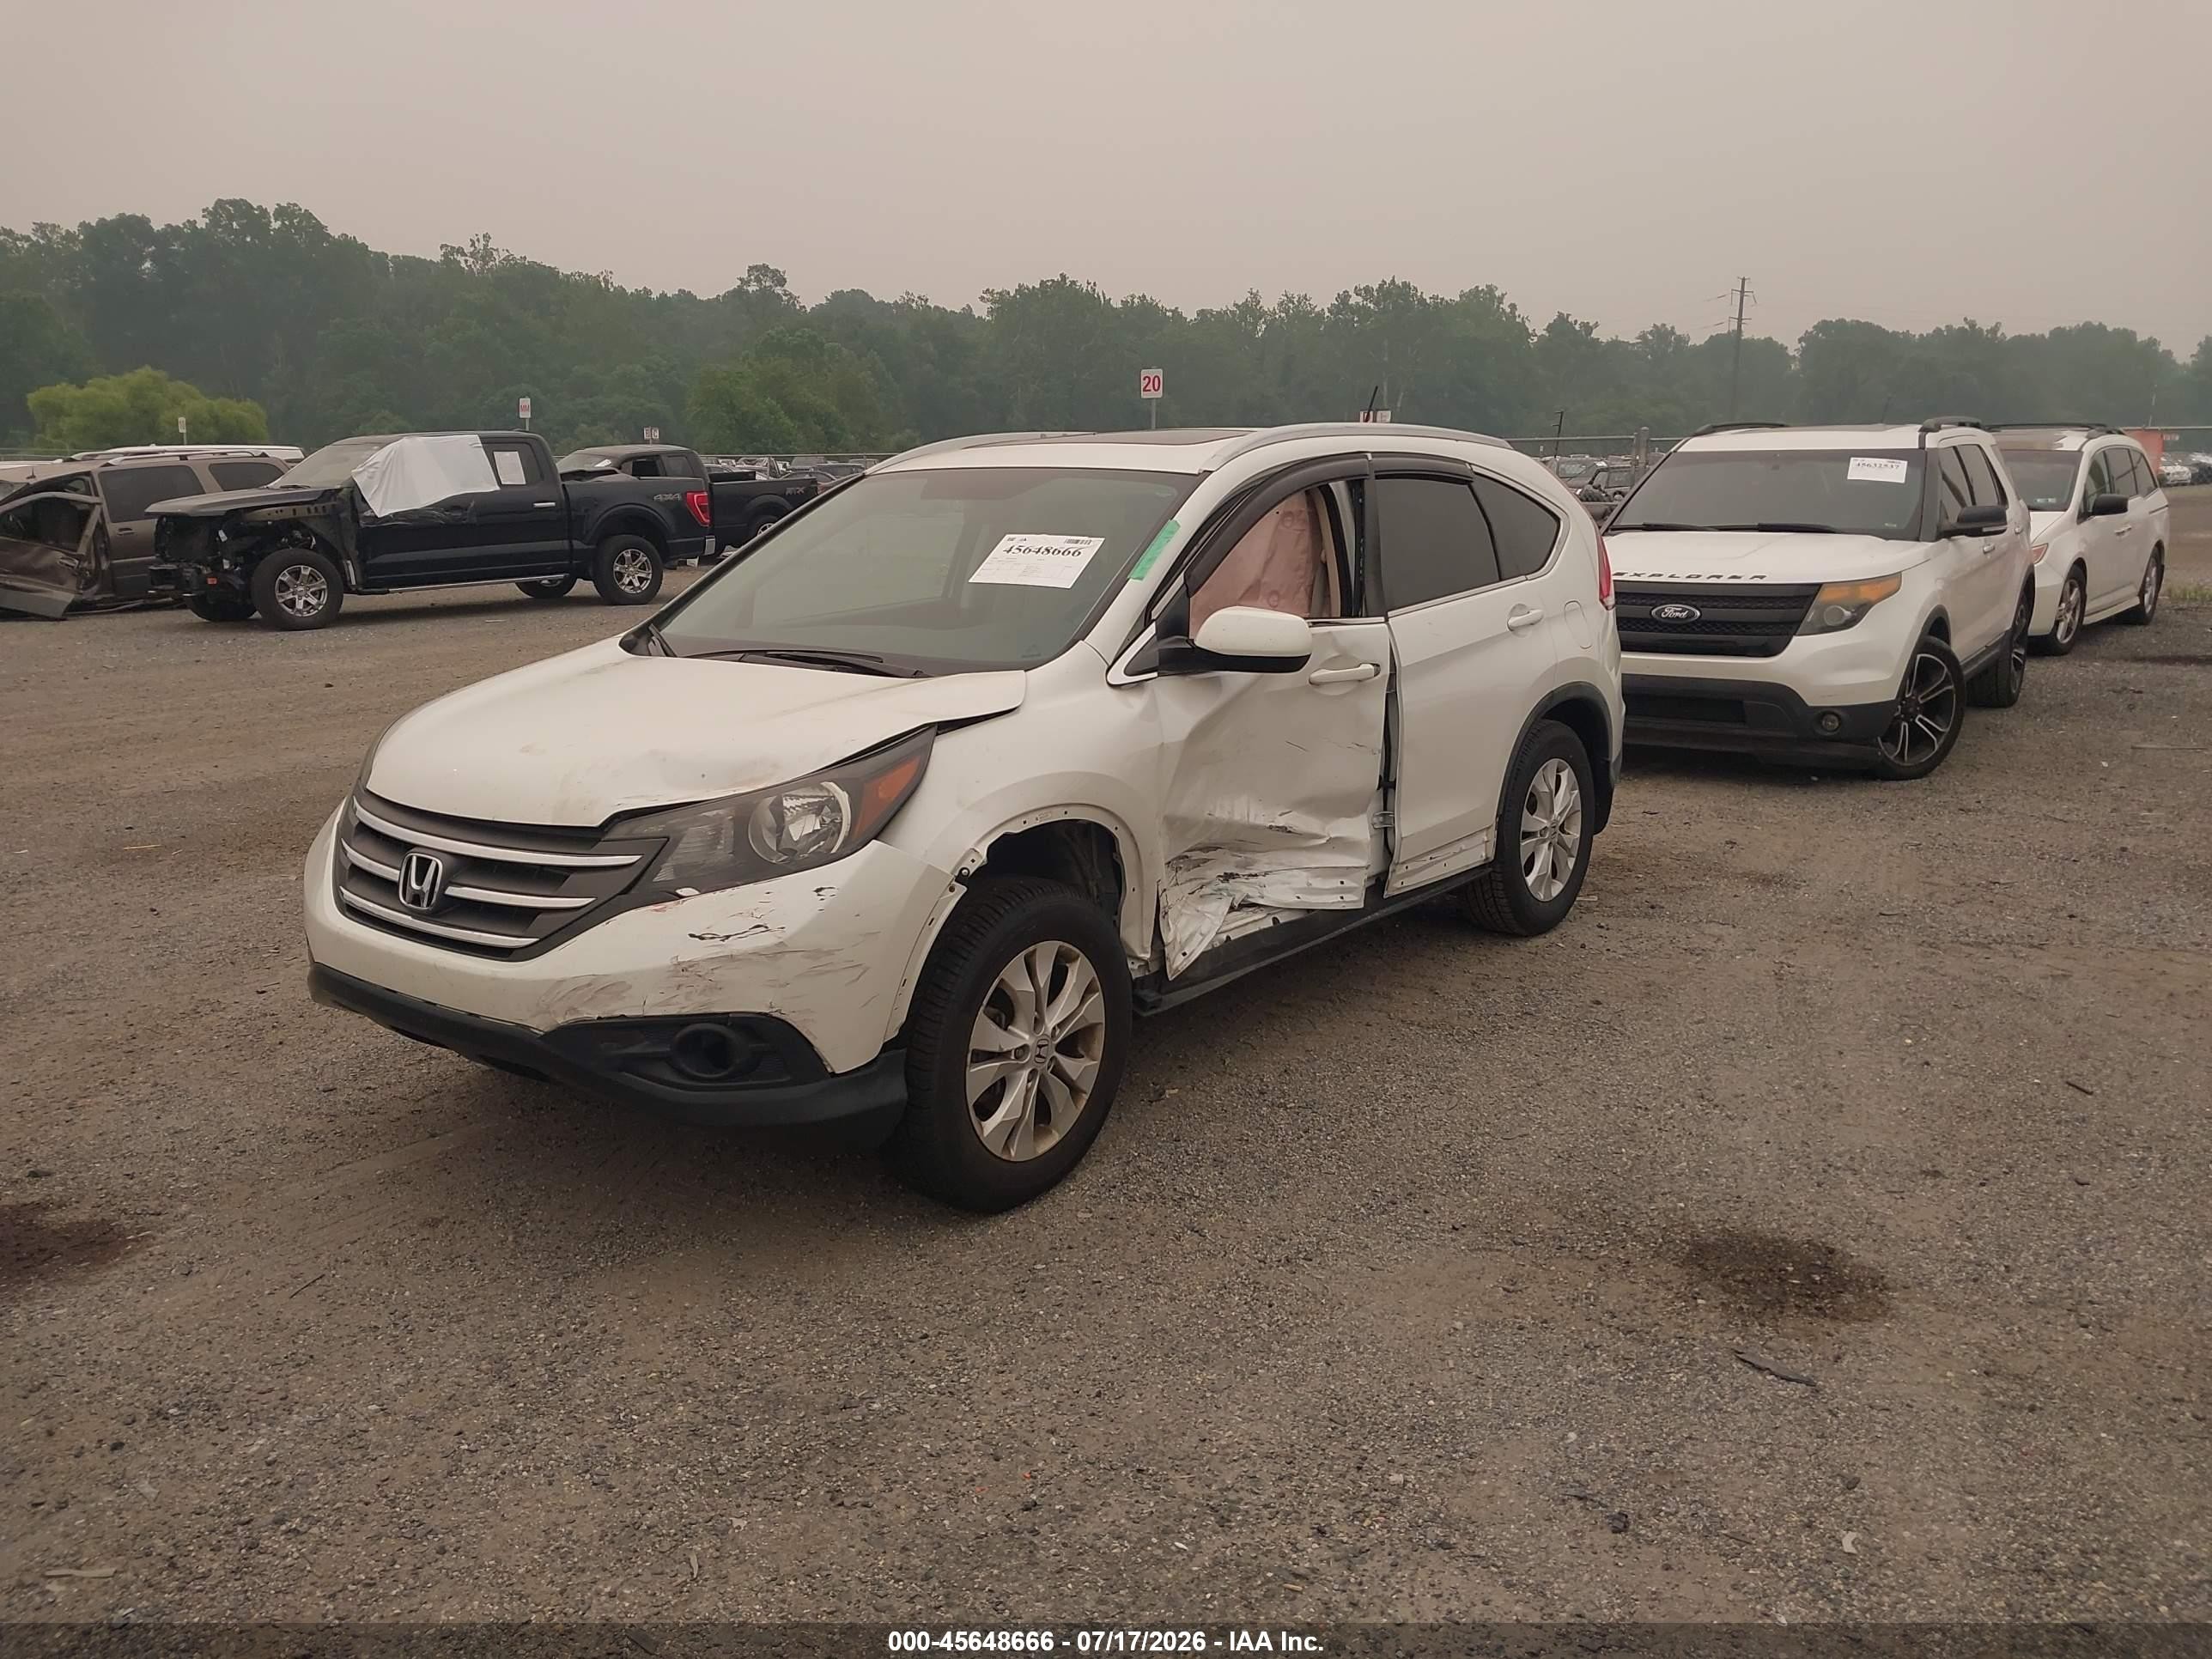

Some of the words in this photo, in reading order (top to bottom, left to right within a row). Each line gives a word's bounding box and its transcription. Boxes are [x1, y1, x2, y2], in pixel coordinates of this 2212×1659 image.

[1142, 375, 1161, 392] 20
[1003, 544, 1084, 557] 45648666
[1613, 572, 1767, 580] EXPLORER
